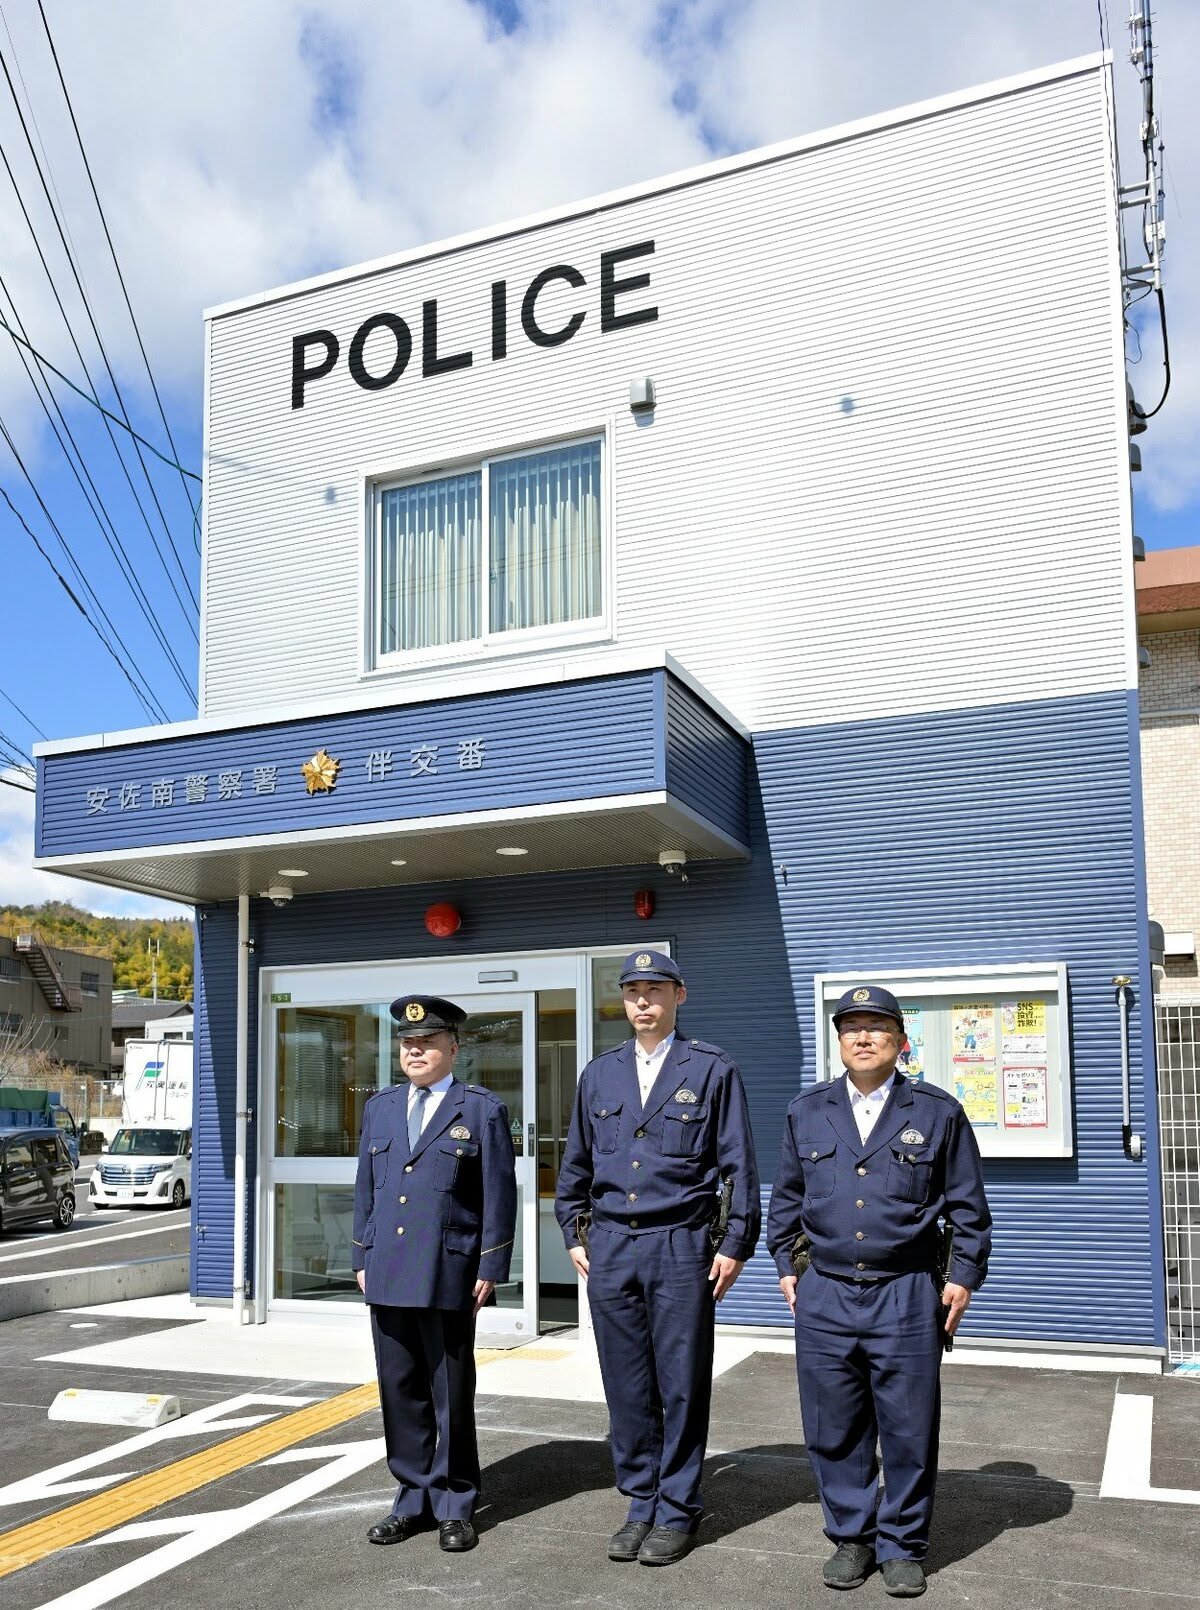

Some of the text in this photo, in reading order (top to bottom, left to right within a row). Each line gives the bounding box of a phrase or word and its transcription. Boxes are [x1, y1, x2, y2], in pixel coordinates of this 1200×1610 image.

[292, 240, 658, 410] POLICE
[86, 738, 486, 815] 安佐南警察署 伴交番
[1017, 1002, 1033, 1010] SNS
